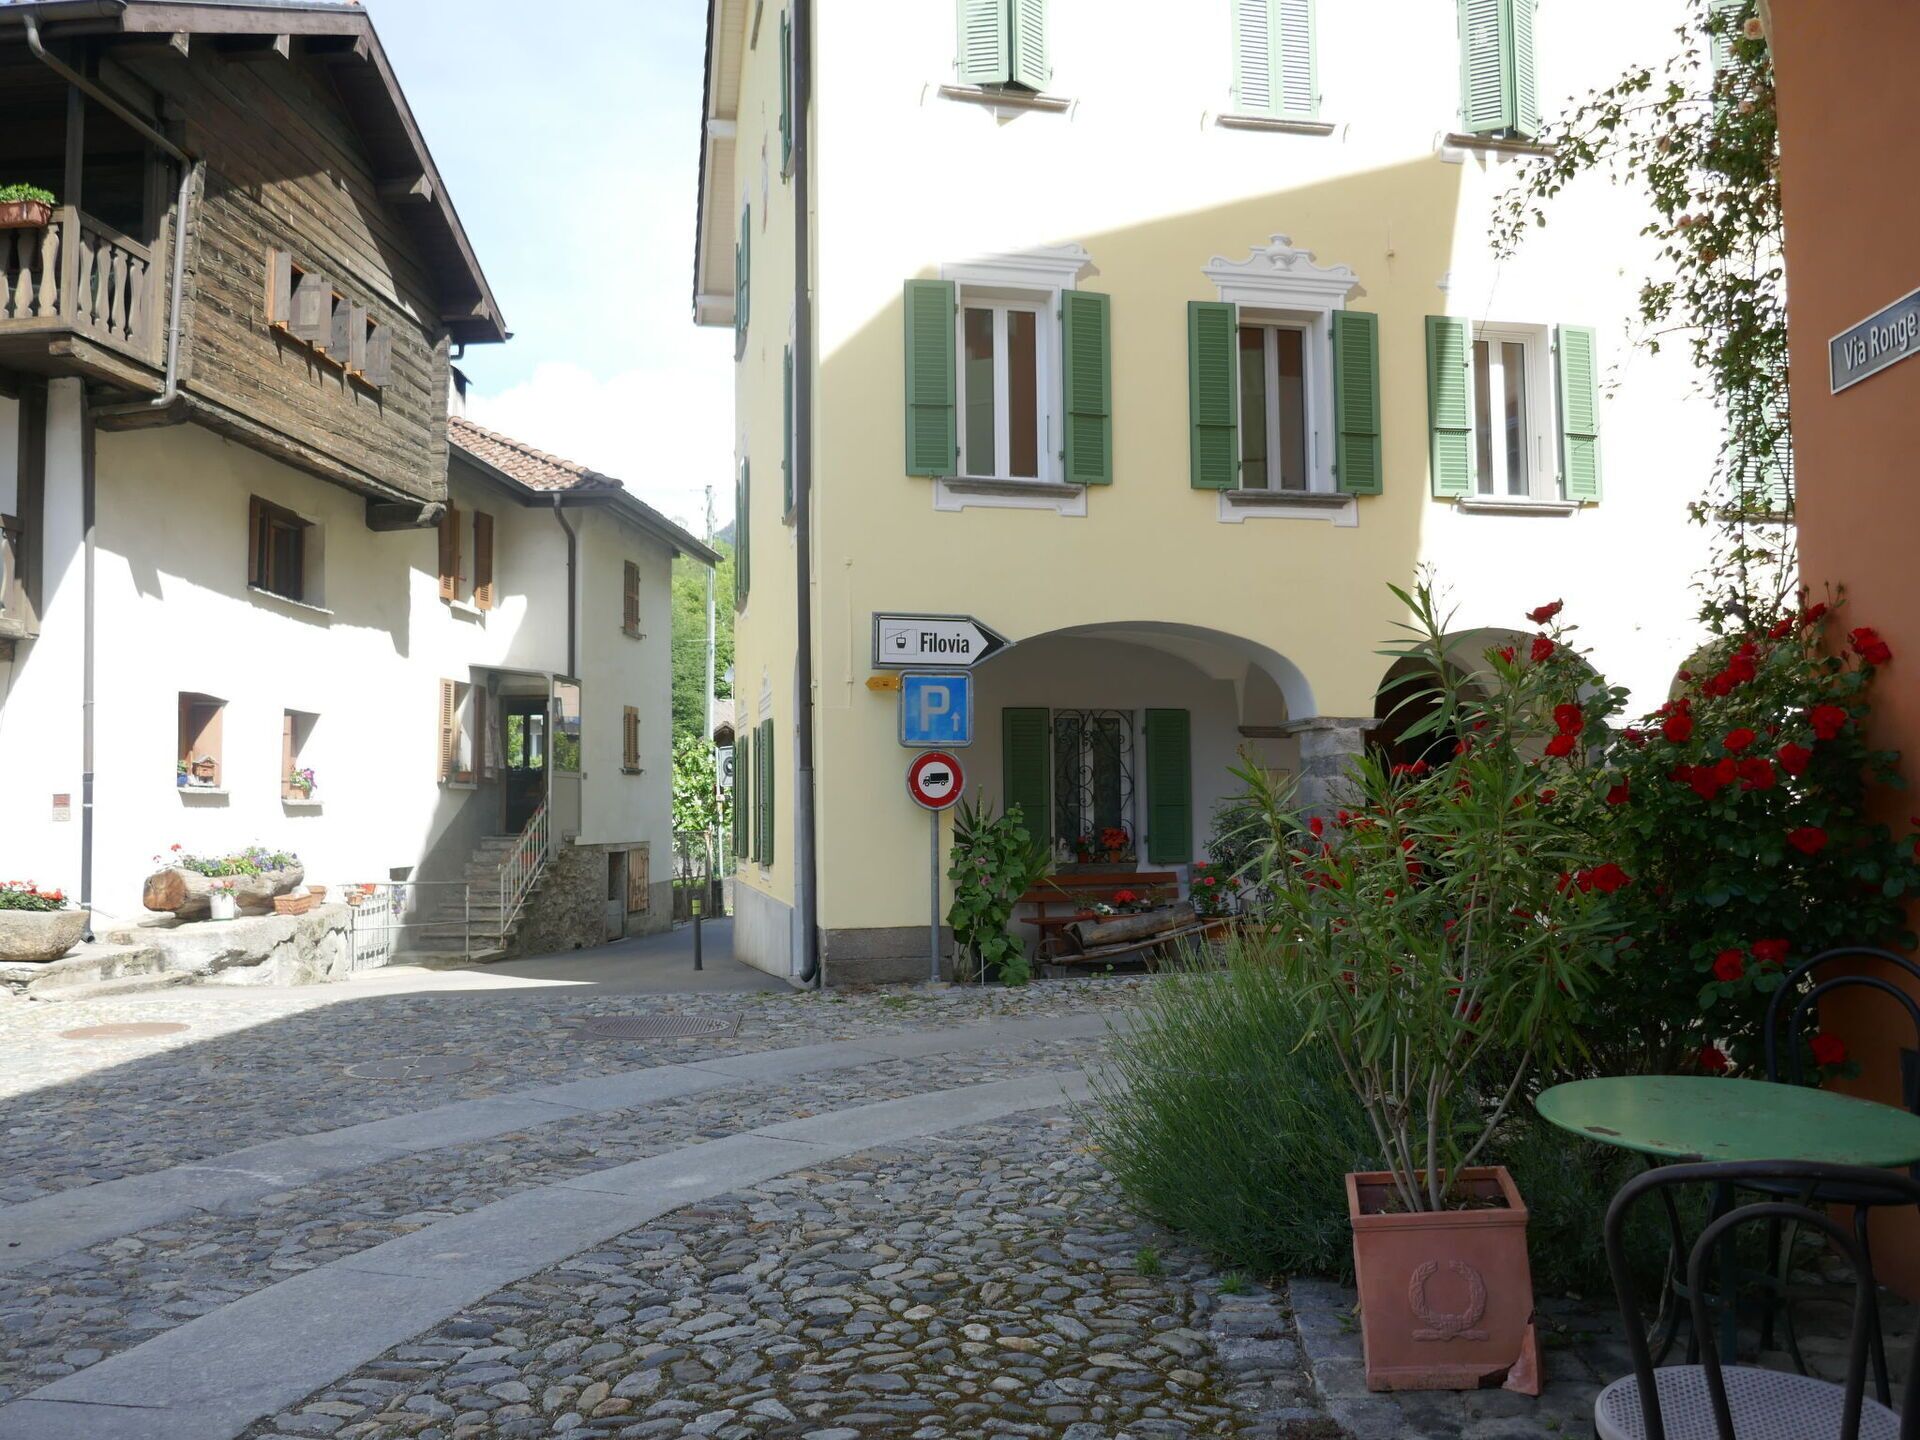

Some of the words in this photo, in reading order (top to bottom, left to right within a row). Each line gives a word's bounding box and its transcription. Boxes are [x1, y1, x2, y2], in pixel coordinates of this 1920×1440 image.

[1843, 336, 1867, 371] Via
[1870, 312, 1917, 358] Ronge
[920, 631, 970, 654] Filovia
[920, 685, 950, 732] P
